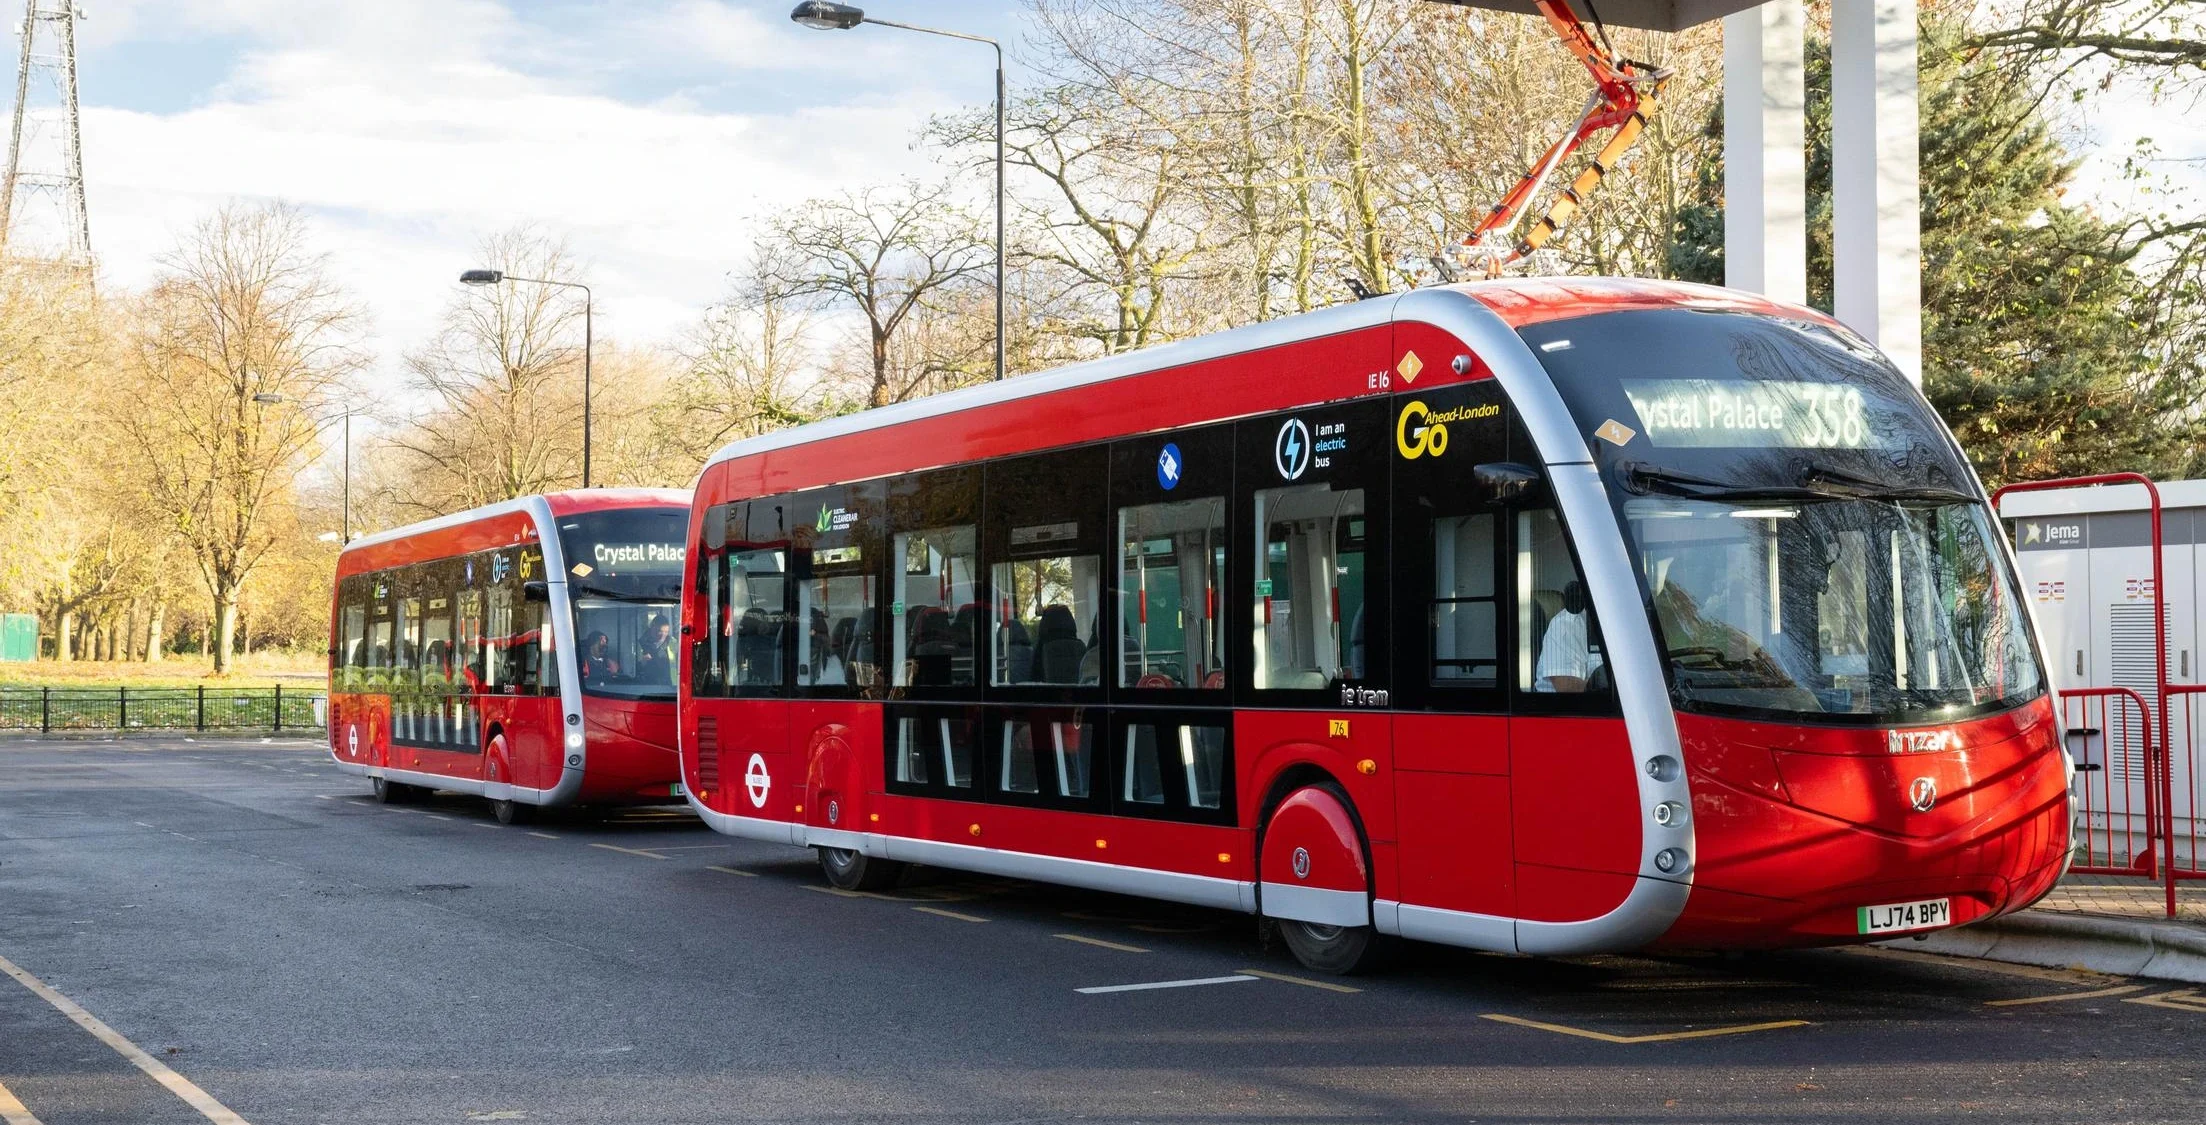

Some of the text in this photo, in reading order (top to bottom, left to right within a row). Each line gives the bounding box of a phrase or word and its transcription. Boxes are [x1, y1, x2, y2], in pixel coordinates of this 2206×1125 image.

[1379, 371, 1389, 388] 16
[1425, 403, 1499, 425] Ahead-London
[1708, 394, 1784, 430] Palace
[1800, 391, 1861, 446] 358
[1320, 425, 1333, 435] am
[1334, 422, 1345, 433] an
[1397, 401, 1448, 460] Go
[1315, 437, 1346, 452] electric
[1315, 455, 1330, 468] bus
[2045, 523, 2080, 543] Jema
[594, 543, 685, 566] Crystal Palac
[1356, 685, 1389, 706] tram
[1335, 721, 1345, 736] 76
[1870, 901, 1948, 929] LJ74 BPY
